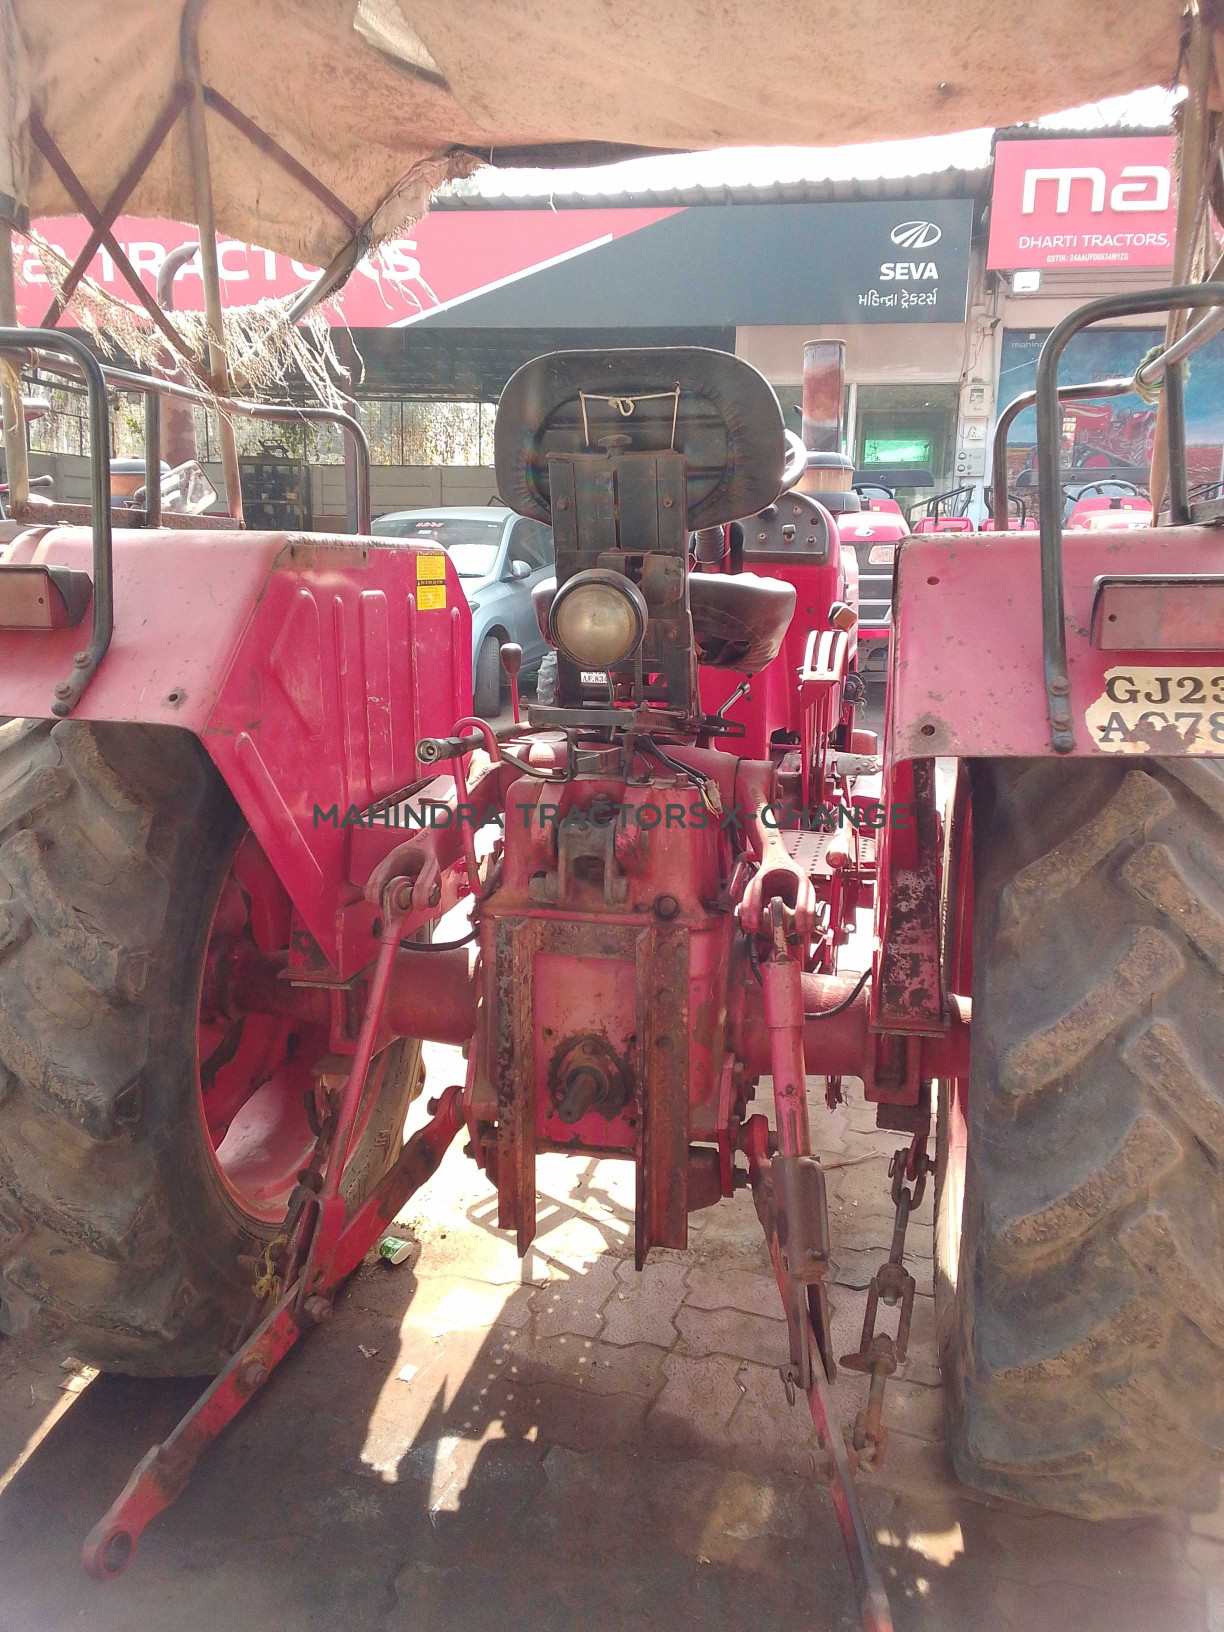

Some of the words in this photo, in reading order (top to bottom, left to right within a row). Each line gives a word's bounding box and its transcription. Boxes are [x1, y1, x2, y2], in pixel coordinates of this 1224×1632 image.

[1018, 235, 1078, 249] DHARTI
[1082, 232, 1171, 248] TRACTORS,
[880, 262, 939, 280] SEVA
[858, 289, 898, 307] મહિન્દ્રા
